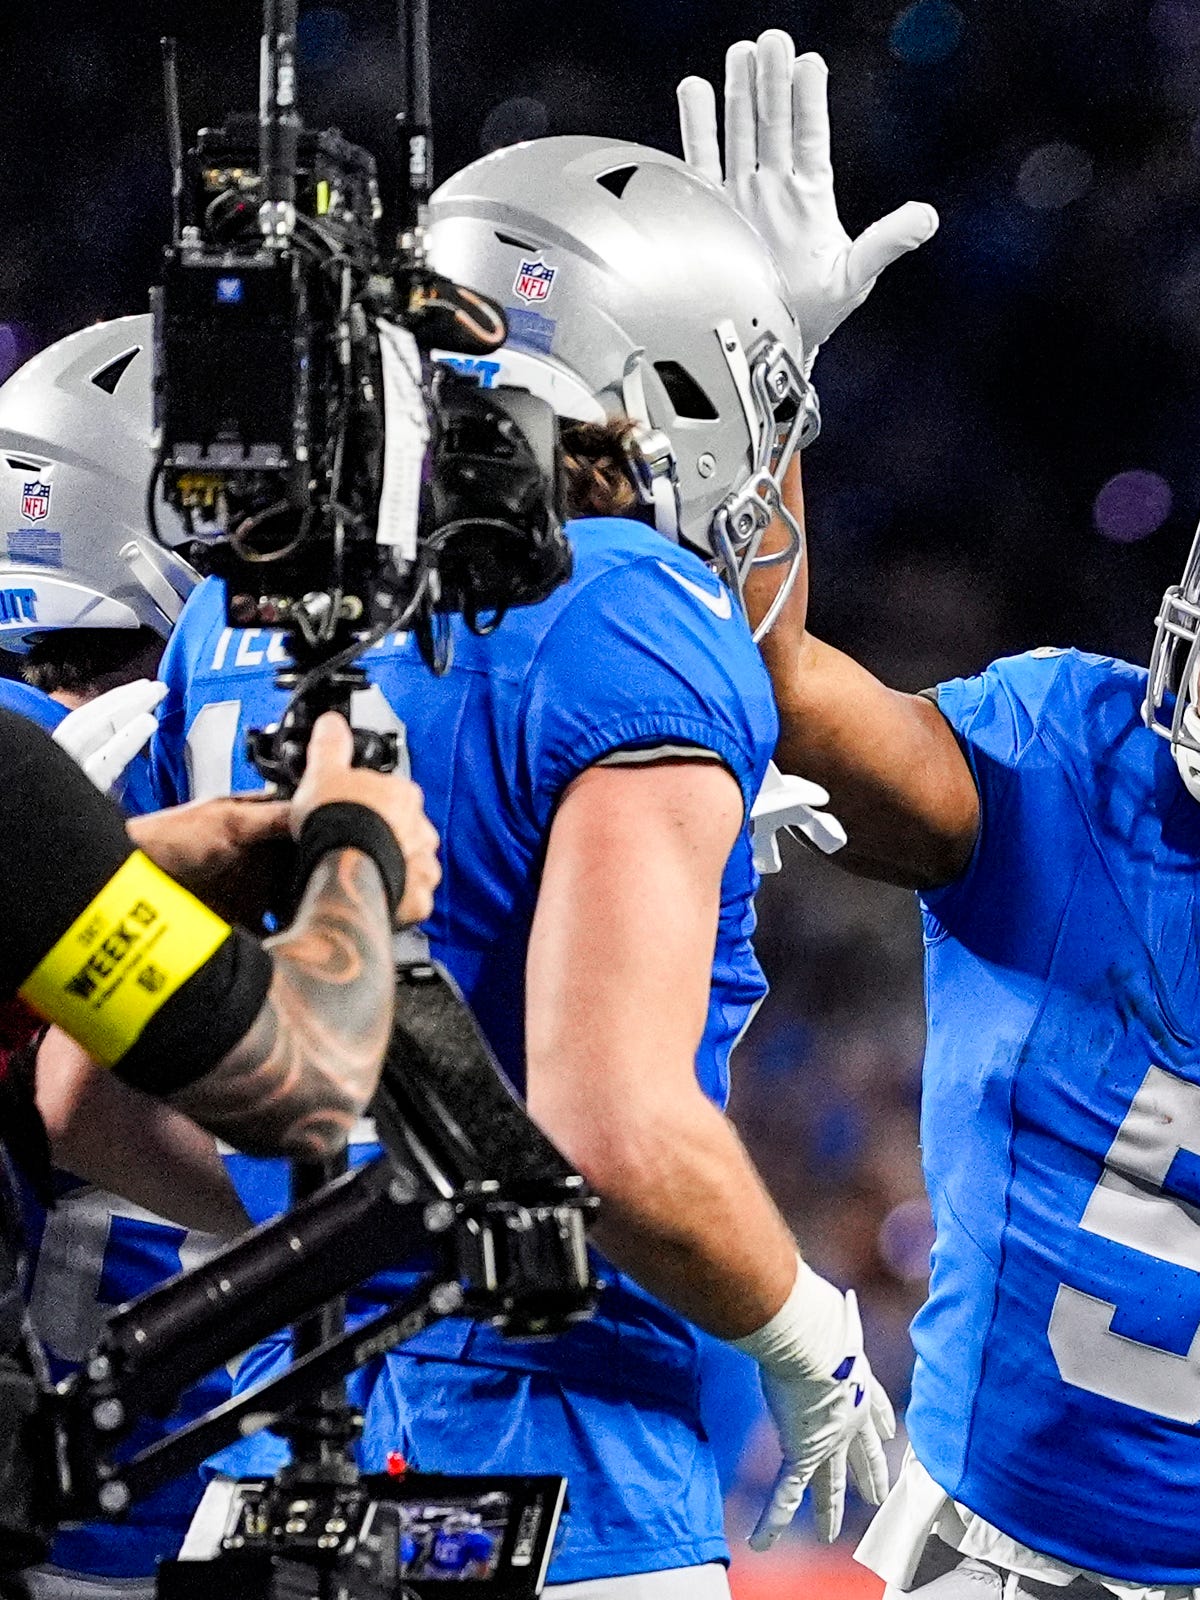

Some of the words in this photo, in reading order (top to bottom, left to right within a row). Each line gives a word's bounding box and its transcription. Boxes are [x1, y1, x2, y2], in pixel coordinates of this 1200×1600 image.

[518, 275, 546, 298] NFL
[23, 496, 46, 517] NFL
[63, 918, 140, 1000] WEEK
